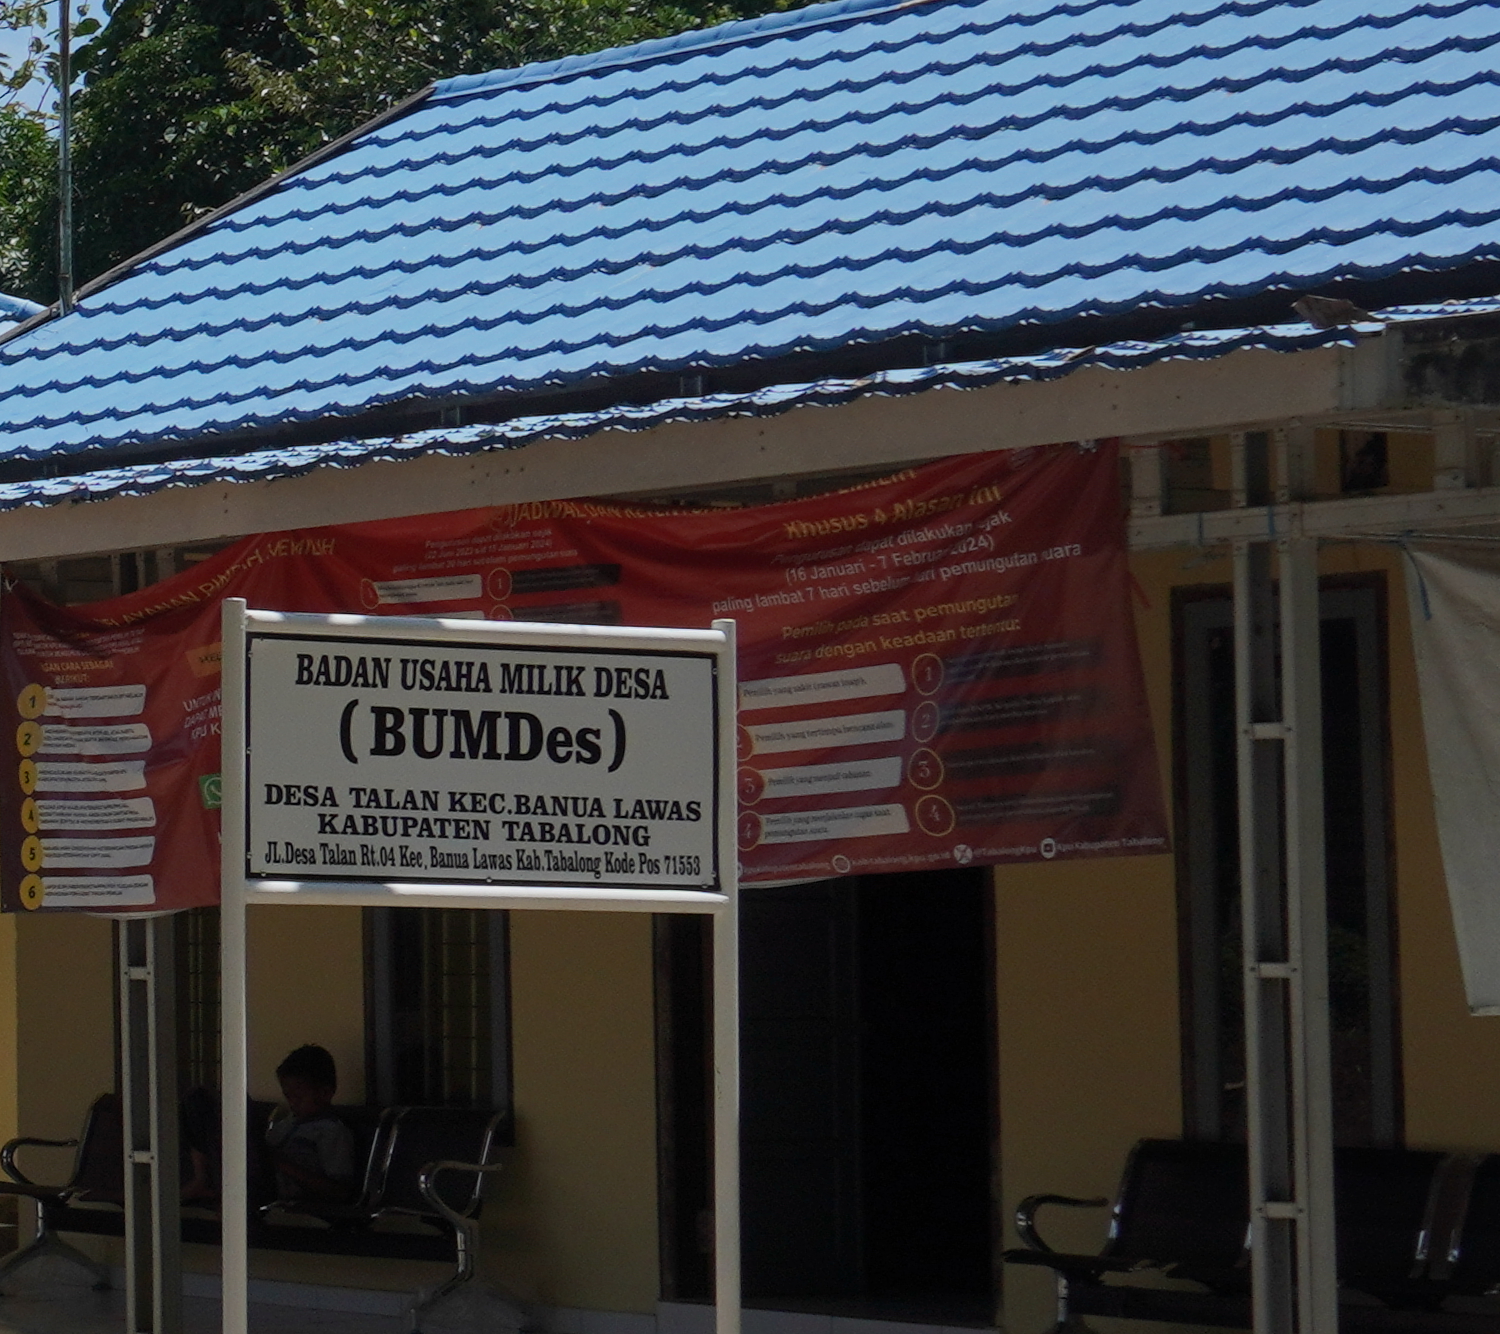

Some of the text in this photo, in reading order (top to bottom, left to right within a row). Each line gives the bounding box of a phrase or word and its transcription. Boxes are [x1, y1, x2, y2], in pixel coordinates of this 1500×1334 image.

[295, 653, 670, 700] BADAN USAHA MILIK DESA
[28, 696, 36, 709] 1
[23, 734, 31, 745] 2
[24, 771, 30, 783] 3
[264, 783, 340, 808] DESA
[348, 787, 440, 812] TALAN
[613, 798, 702, 823] LAWAS
[27, 810, 34, 821] 4
[317, 813, 651, 847] KABUPATEN TABALONG
[29, 847, 36, 860] 5
[28, 885, 36, 898] 6
